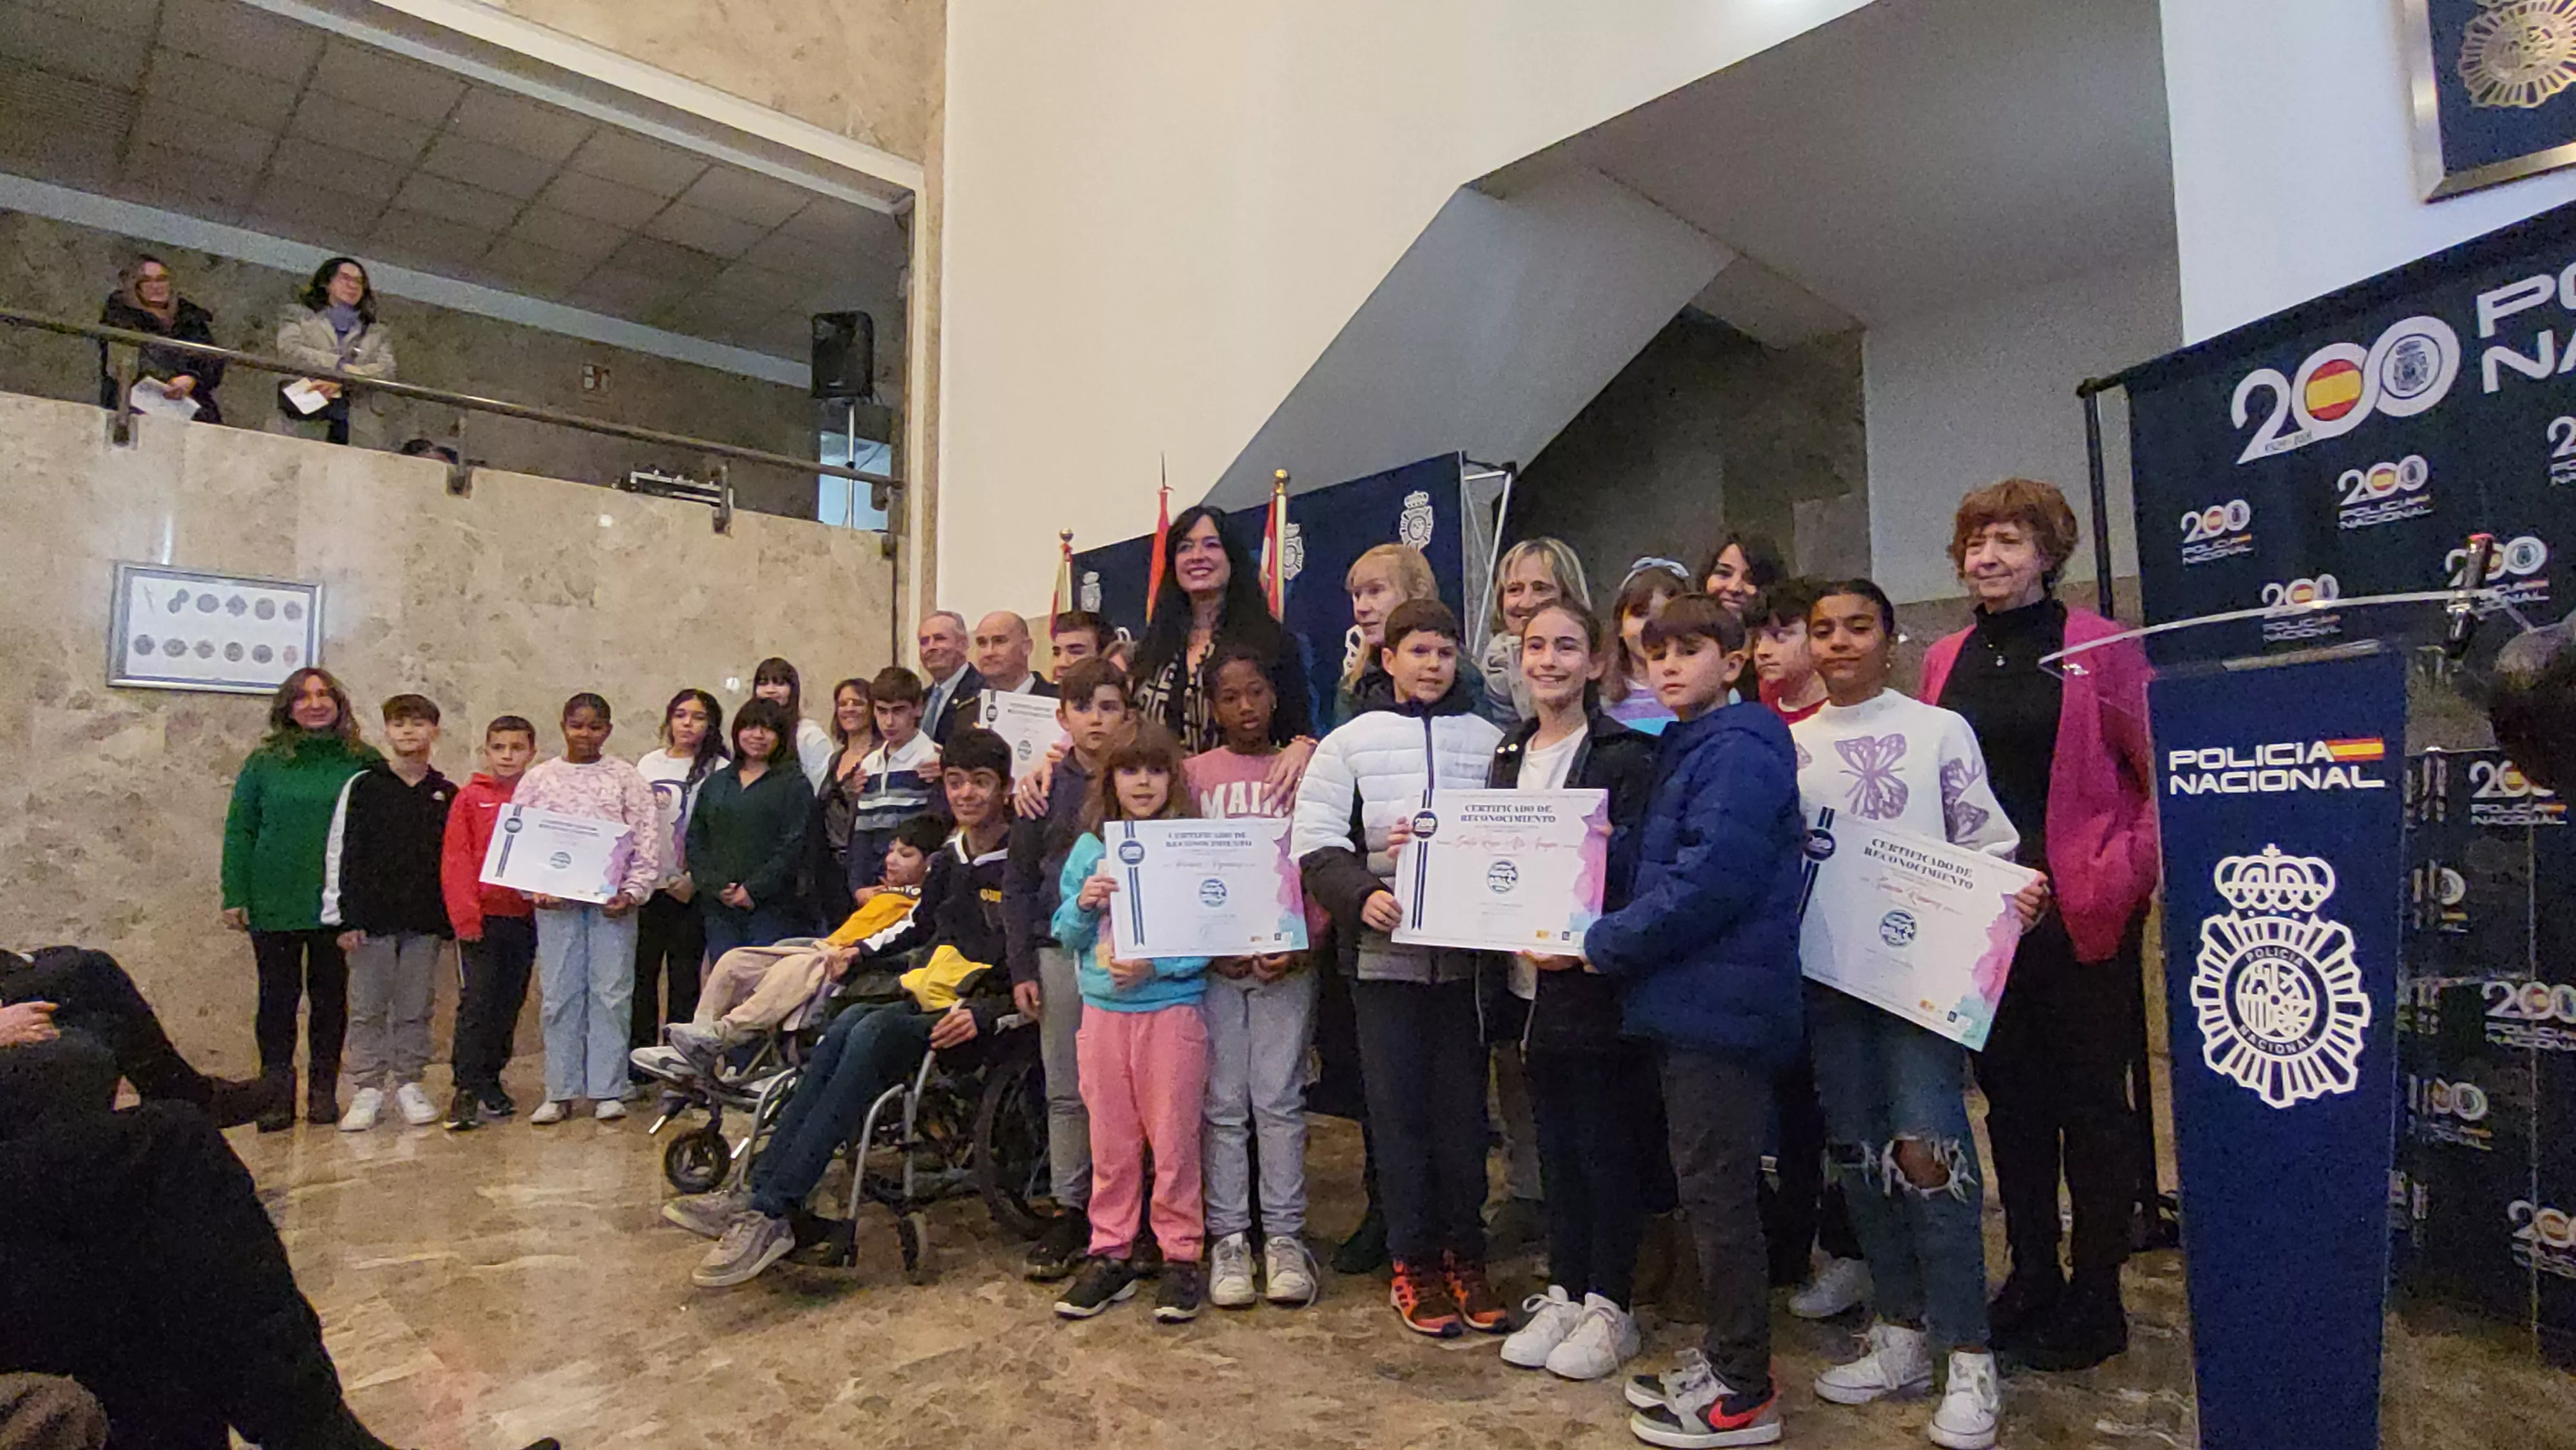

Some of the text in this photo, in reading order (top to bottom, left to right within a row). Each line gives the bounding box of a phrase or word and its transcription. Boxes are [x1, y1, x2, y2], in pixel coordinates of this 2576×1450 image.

[2337, 455, 2429, 506] 200
[2180, 499, 2251, 543] 200
[2170, 766, 2385, 795] NACIONAL
[2244, 947, 2305, 968] POLICIA
[2239, 1024, 2315, 1055] NACIONAL
